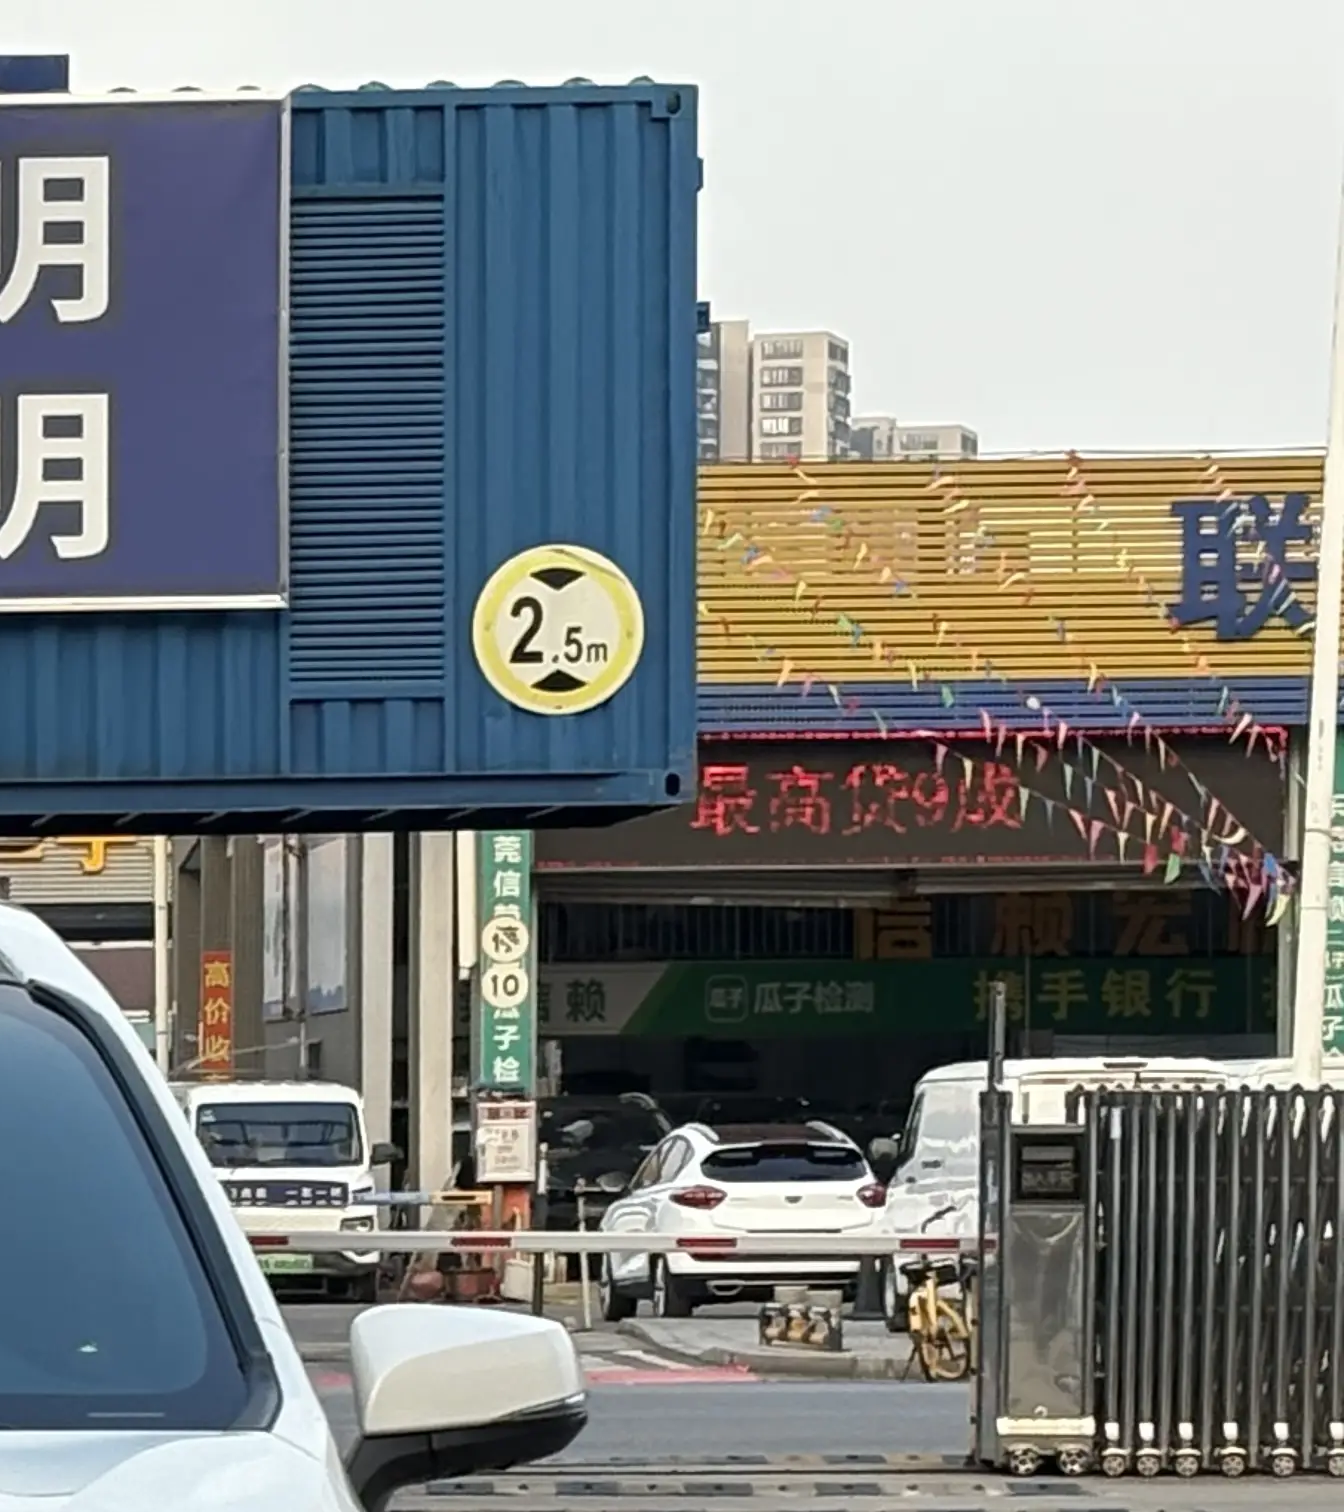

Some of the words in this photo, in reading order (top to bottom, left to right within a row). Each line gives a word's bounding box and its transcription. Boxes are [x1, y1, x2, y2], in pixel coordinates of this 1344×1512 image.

[508, 595, 609, 665] 2.5m
[490, 973, 520, 997] 10
[753, 979, 876, 1016] 瓜子检测
[204, 960, 232, 1080] 高价收
